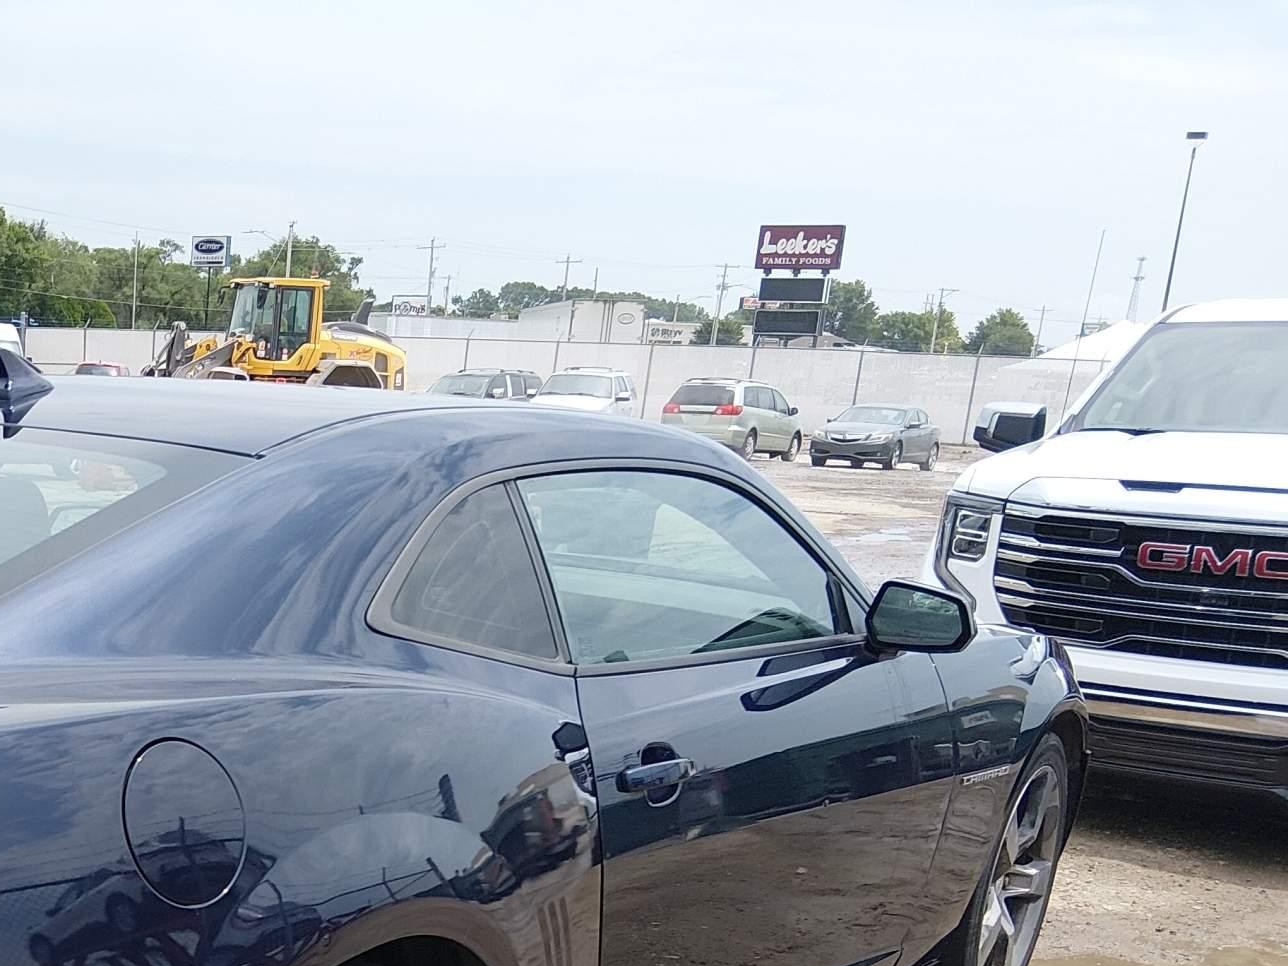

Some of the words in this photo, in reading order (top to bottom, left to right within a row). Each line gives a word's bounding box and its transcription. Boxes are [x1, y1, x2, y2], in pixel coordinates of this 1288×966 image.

[760, 231, 838, 255] Leeker's
[762, 257, 797, 265] FAMILY
[799, 257, 831, 265] FOODS
[1137, 541, 1288, 580] GMC
